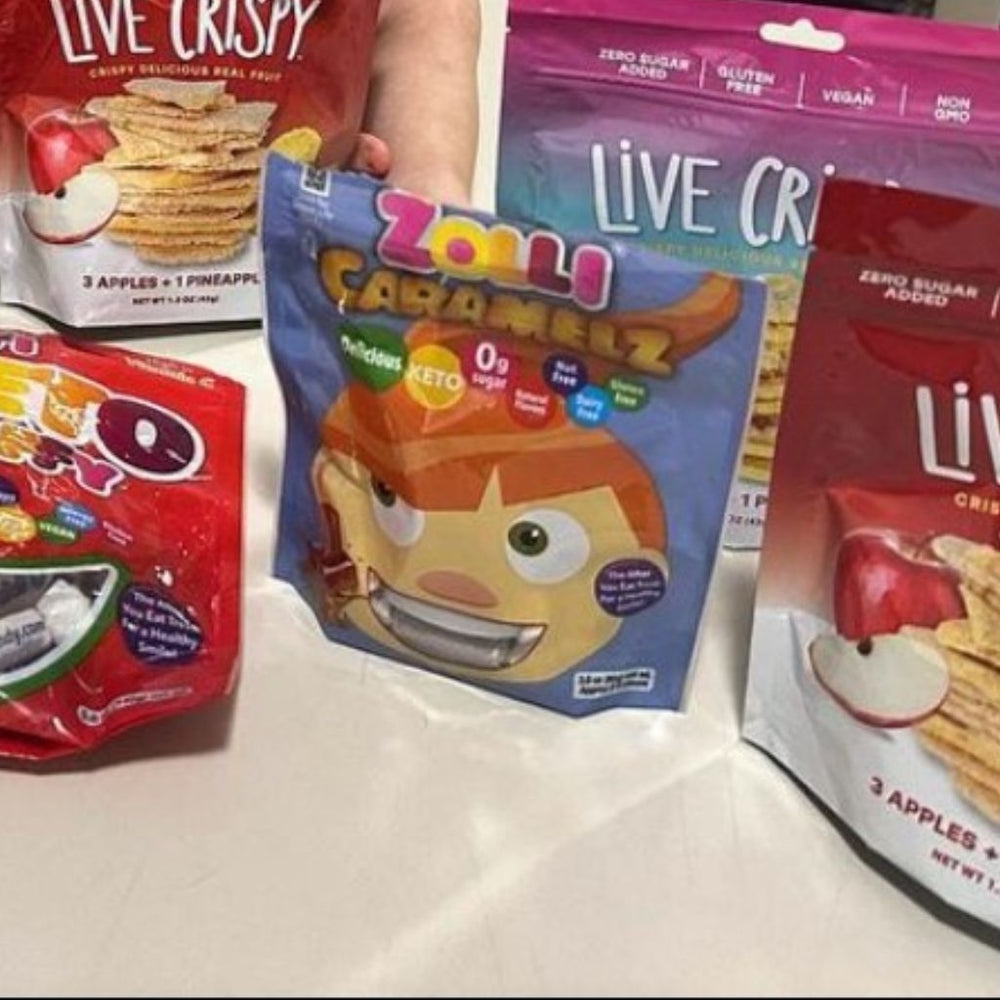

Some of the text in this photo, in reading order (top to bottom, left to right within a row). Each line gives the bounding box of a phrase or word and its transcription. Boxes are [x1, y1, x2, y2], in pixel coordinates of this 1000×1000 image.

[89, 64, 134, 79] CRISPY
[138, 63, 209, 77] DELICIOUS
[213, 65, 245, 78] REAL
[600, 49, 689, 72] ZERO SUGAR
[618, 64, 668, 81] ADDED
[717, 66, 775, 85] GLUTEN
[726, 79, 761, 95] FREE
[822, 89, 875, 107] VEGAN
[936, 94, 971, 109] NON
[934, 107, 970, 122] GMO
[376, 188, 613, 310] ZOLLI
[83, 275, 93, 289] 3
[97, 275, 158, 290] APPLES
[177, 275, 183, 288] 1
[187, 272, 261, 288] PINEAPPL
[859, 269, 979, 299] ZERO SUGAR
[883, 286, 949, 308] ADDED
[341, 334, 403, 371] Delicious
[475, 342, 509, 375] 0g
[407, 361, 462, 390] KETO
[471, 371, 508, 391] sugar
[552, 371, 578, 386] Free
[953, 491, 1000, 517] CRIS
[869, 775, 884, 797] 3
[886, 790, 978, 851] APPLES
[930, 848, 960, 871] NET
[961, 865, 985, 885] WT
